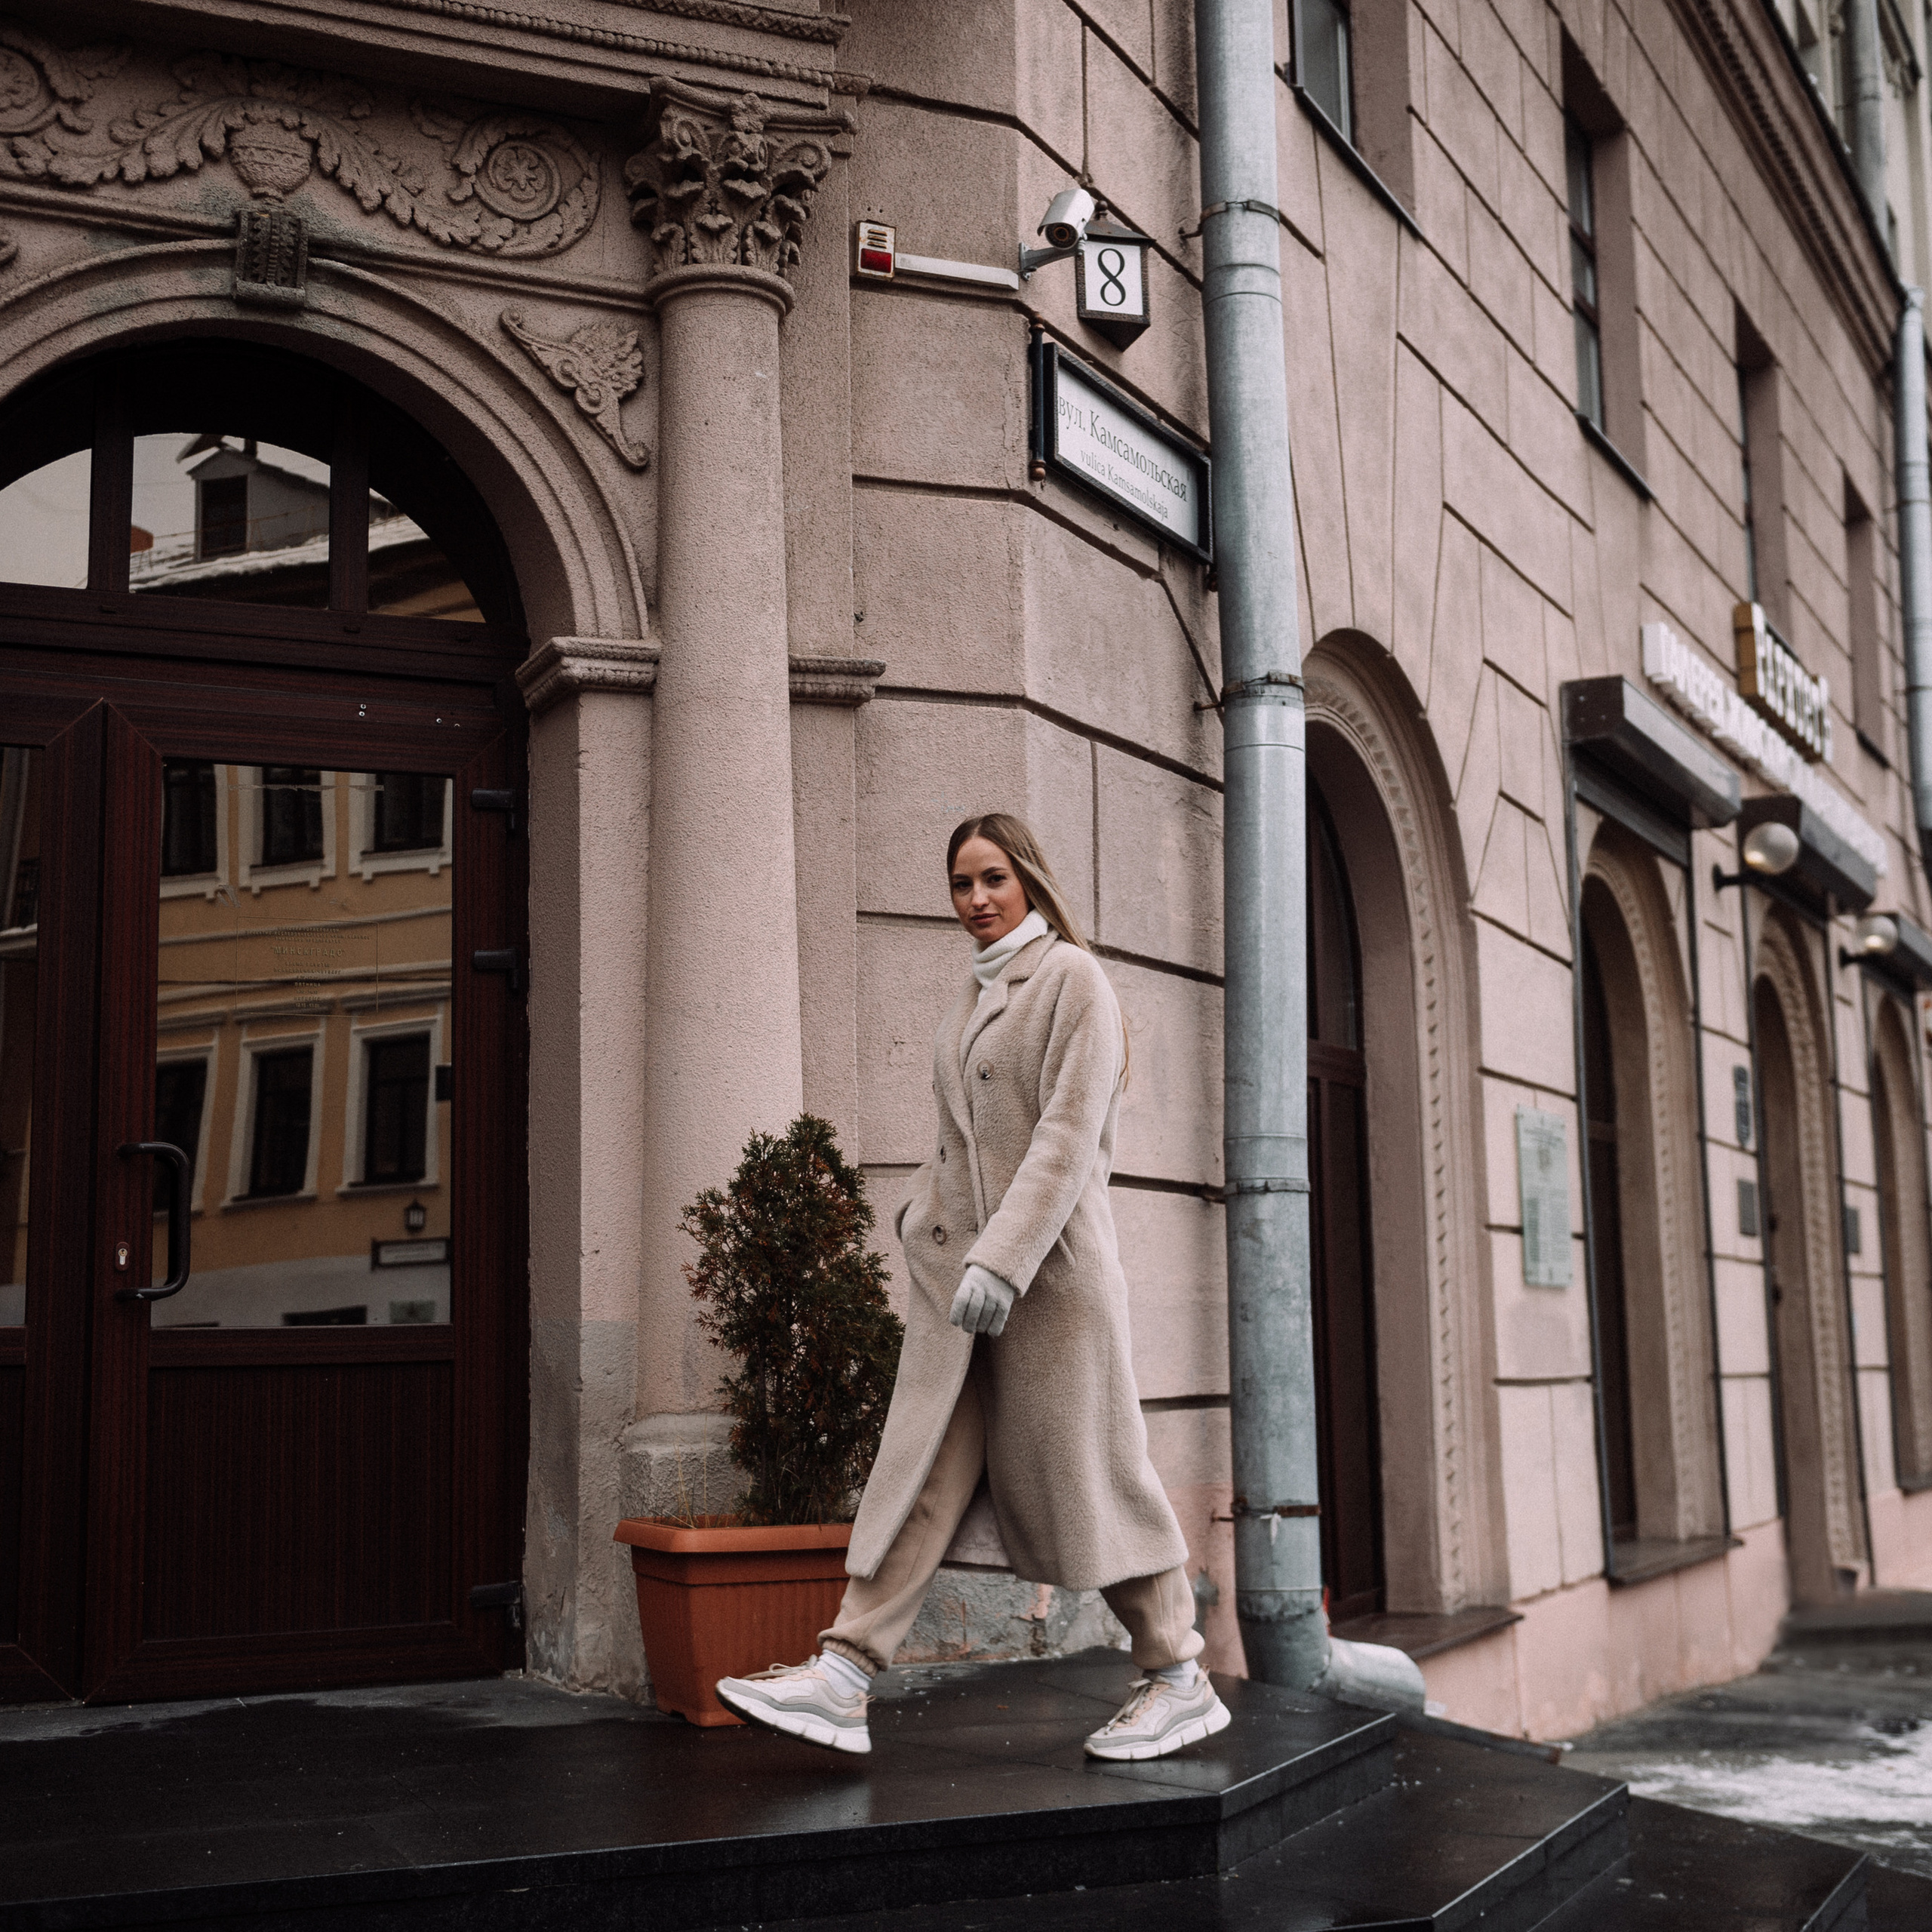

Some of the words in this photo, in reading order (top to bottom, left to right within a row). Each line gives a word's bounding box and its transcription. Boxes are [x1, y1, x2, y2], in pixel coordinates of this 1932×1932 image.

[1097, 248, 1127, 306] 8
[1058, 395, 1086, 432] вул.
[1089, 409, 1187, 503] Камсамольская
[1080, 449, 1106, 476] vulica
